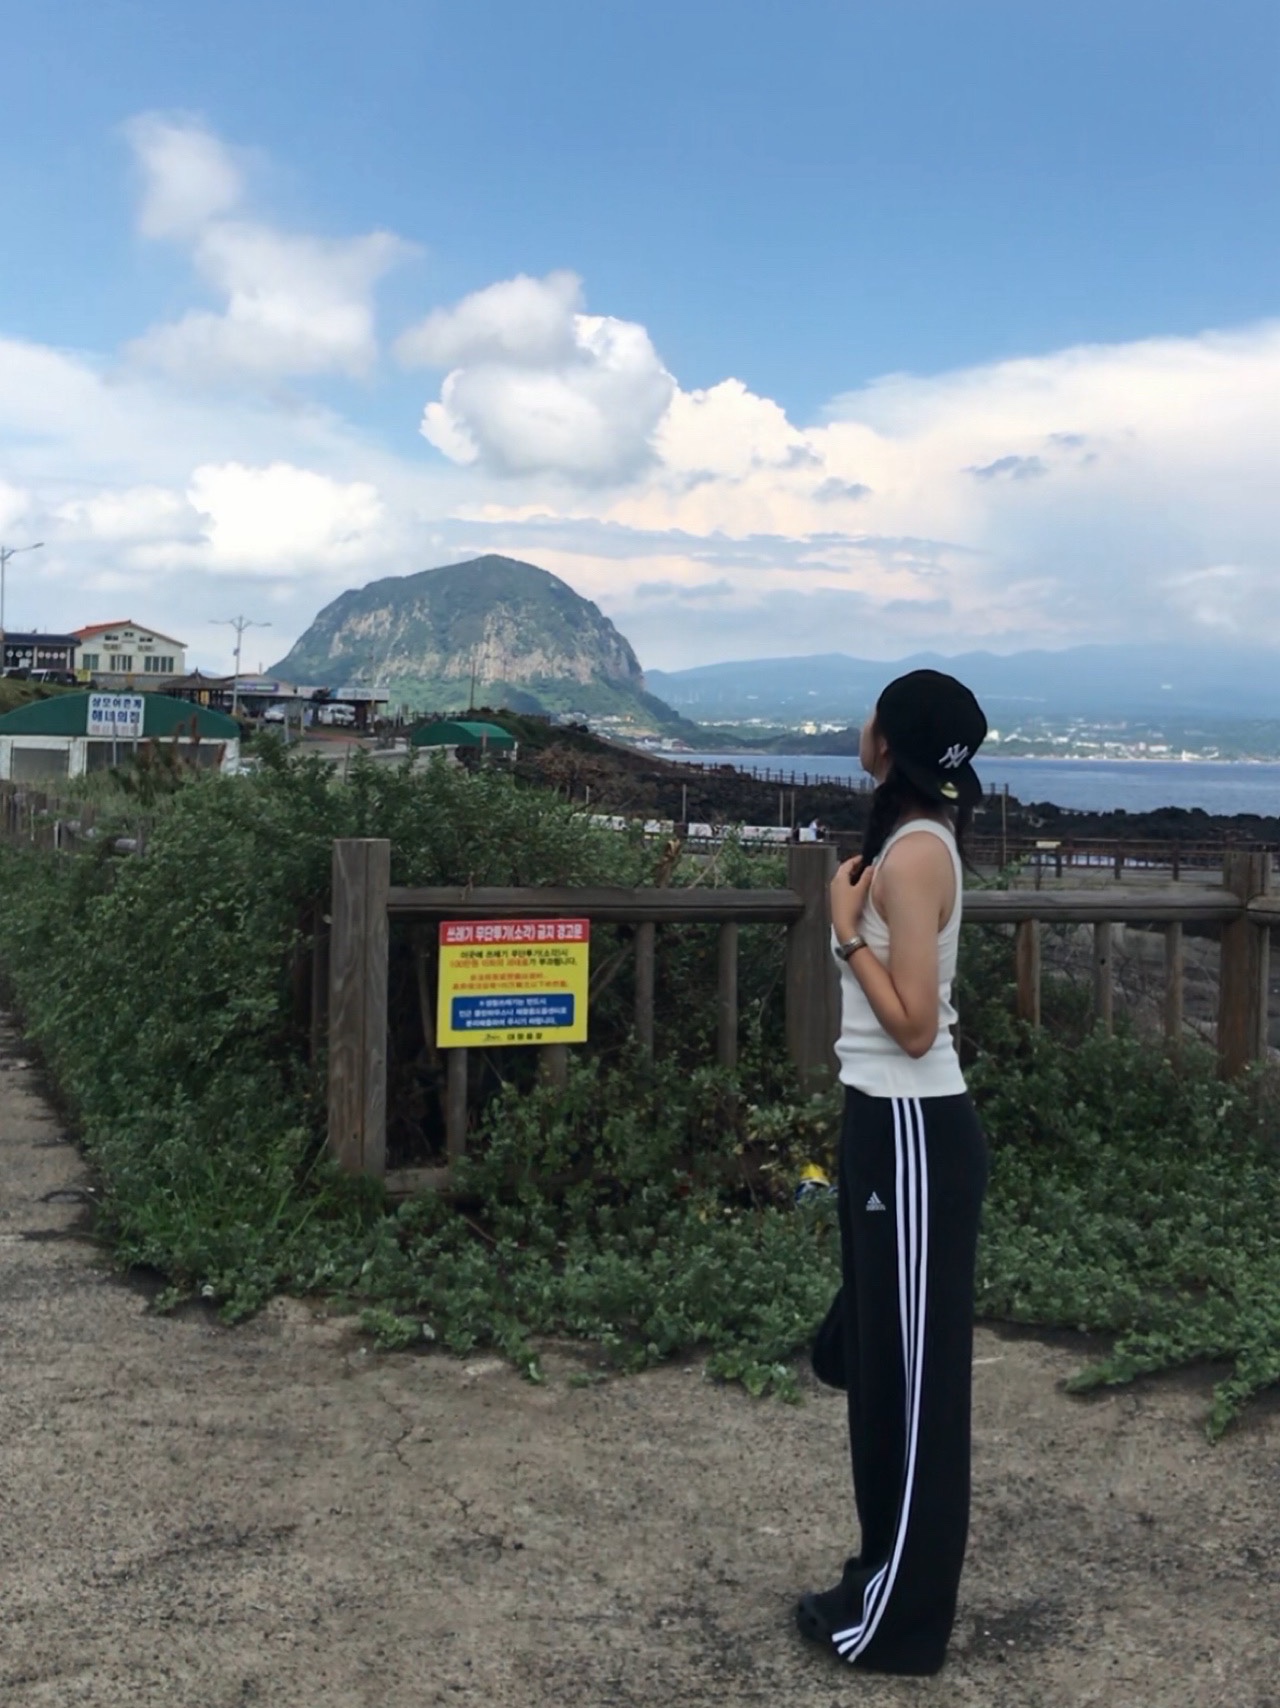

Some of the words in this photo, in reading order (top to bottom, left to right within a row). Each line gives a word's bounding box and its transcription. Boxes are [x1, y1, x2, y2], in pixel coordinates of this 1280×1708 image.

[92, 697, 142, 709] 상모어촌계
[938, 743, 970, 768] NY
[447, 926, 474, 942] 쓰레기
[537, 924, 555, 940] 금지
[557, 923, 583, 939] 경고문
[486, 950, 508, 958] 쓰레기
